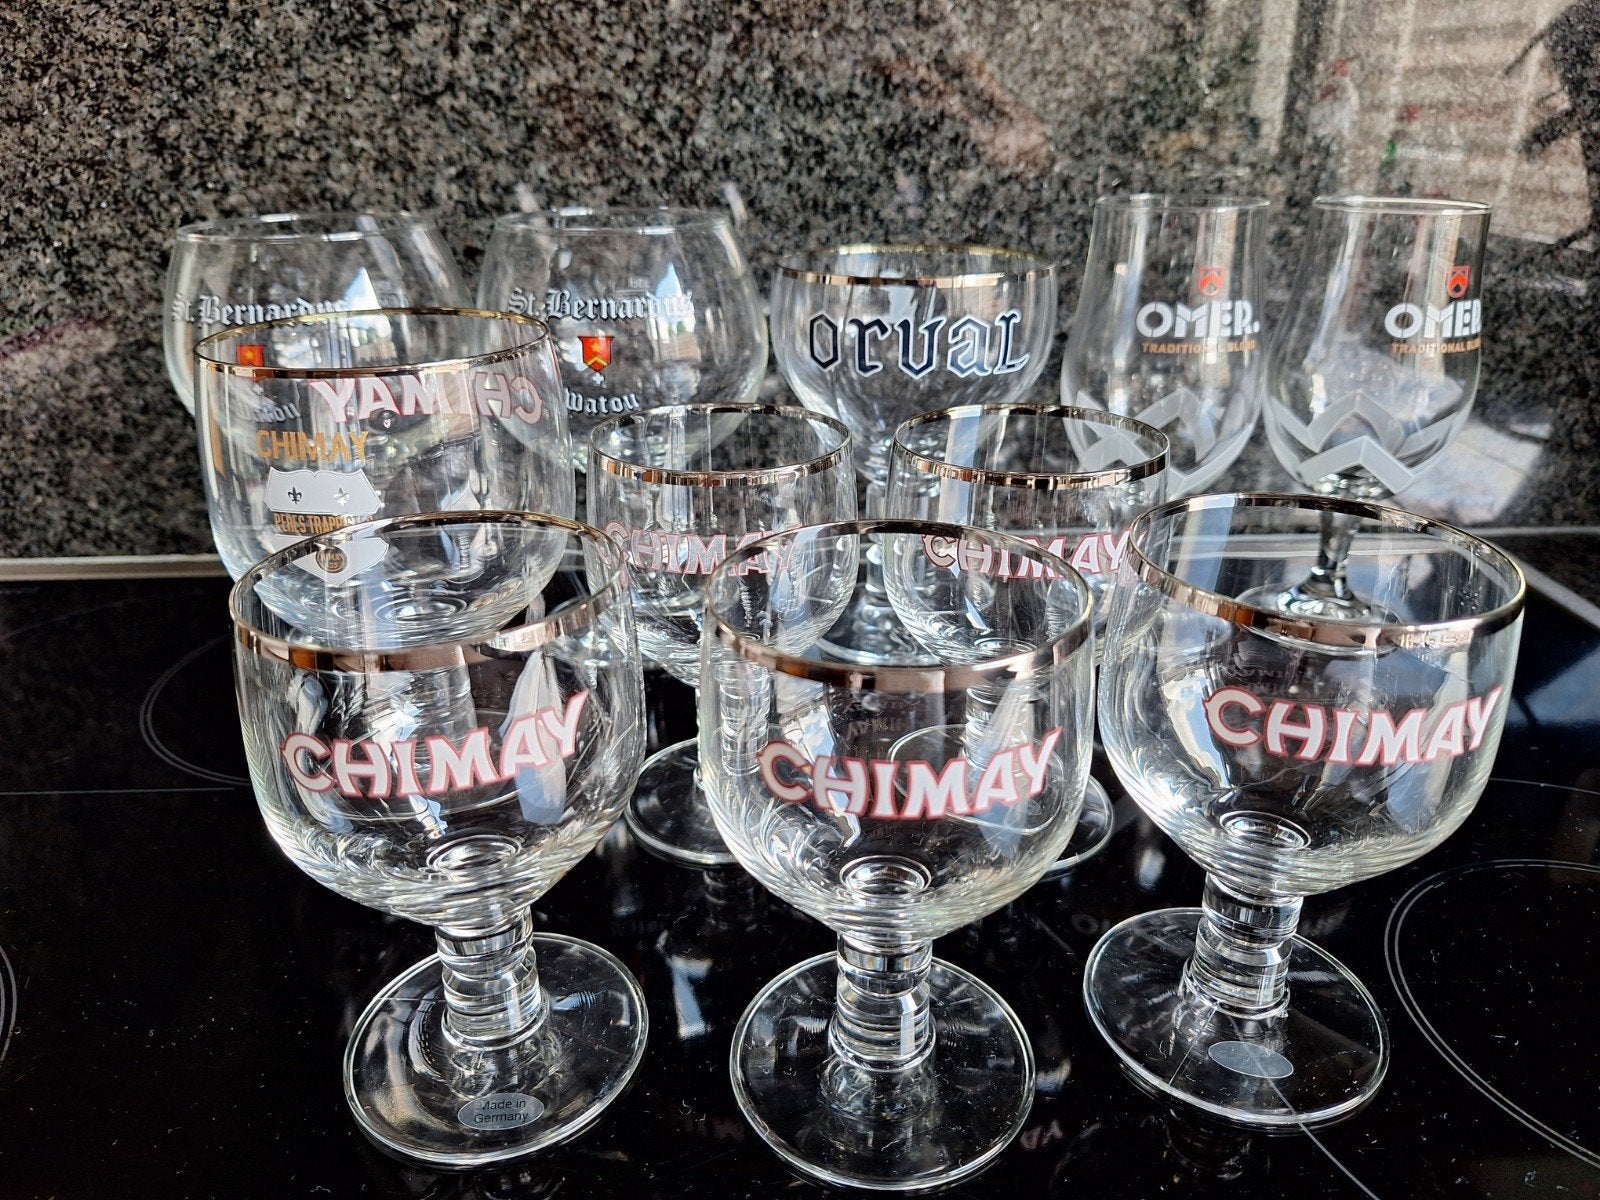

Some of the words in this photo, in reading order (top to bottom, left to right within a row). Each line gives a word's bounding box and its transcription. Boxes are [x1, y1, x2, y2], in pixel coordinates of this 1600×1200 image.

[255, 429, 369, 462] CHIMAY
[273, 512, 307, 534] PERES
[280, 690, 589, 799] CHIMAY
[1202, 684, 1504, 767] CHIMAY
[757, 725, 1064, 821] CHIMAY
[474, 1112, 529, 1123] Germany
